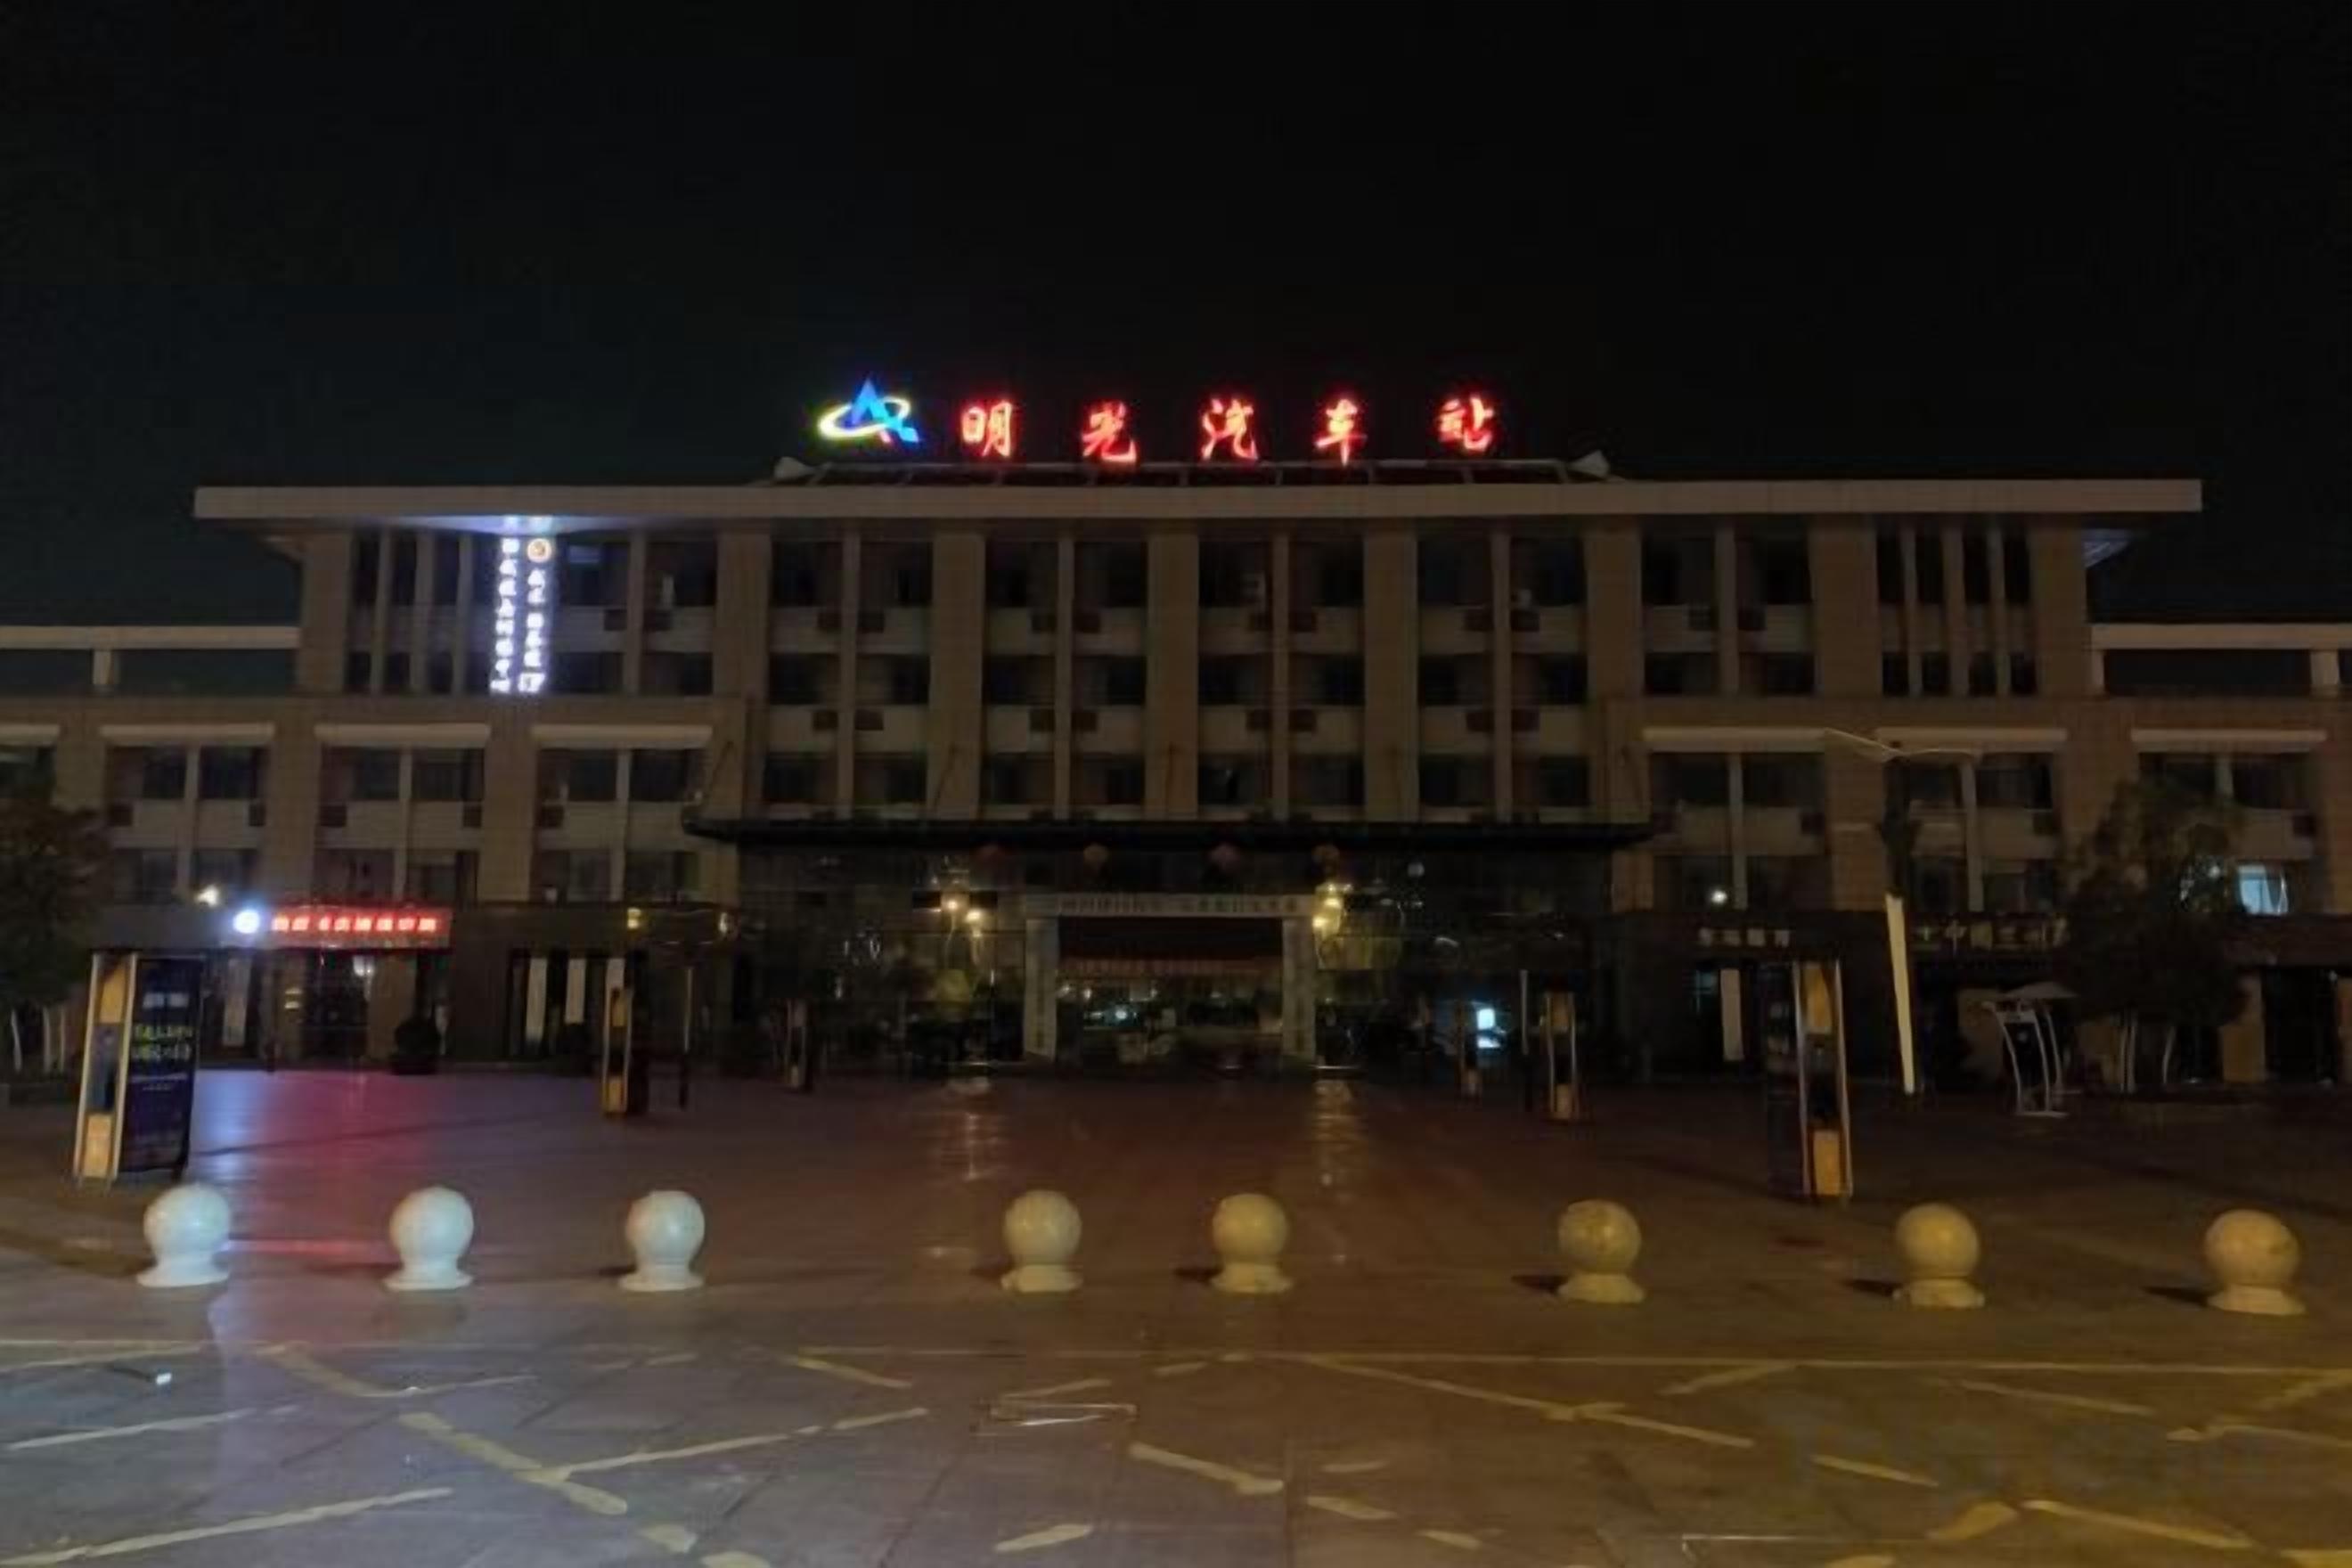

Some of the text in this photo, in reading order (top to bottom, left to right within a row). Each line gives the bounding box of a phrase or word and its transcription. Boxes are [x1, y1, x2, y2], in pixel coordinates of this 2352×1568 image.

[960, 398, 1494, 464] 明光汽车站
